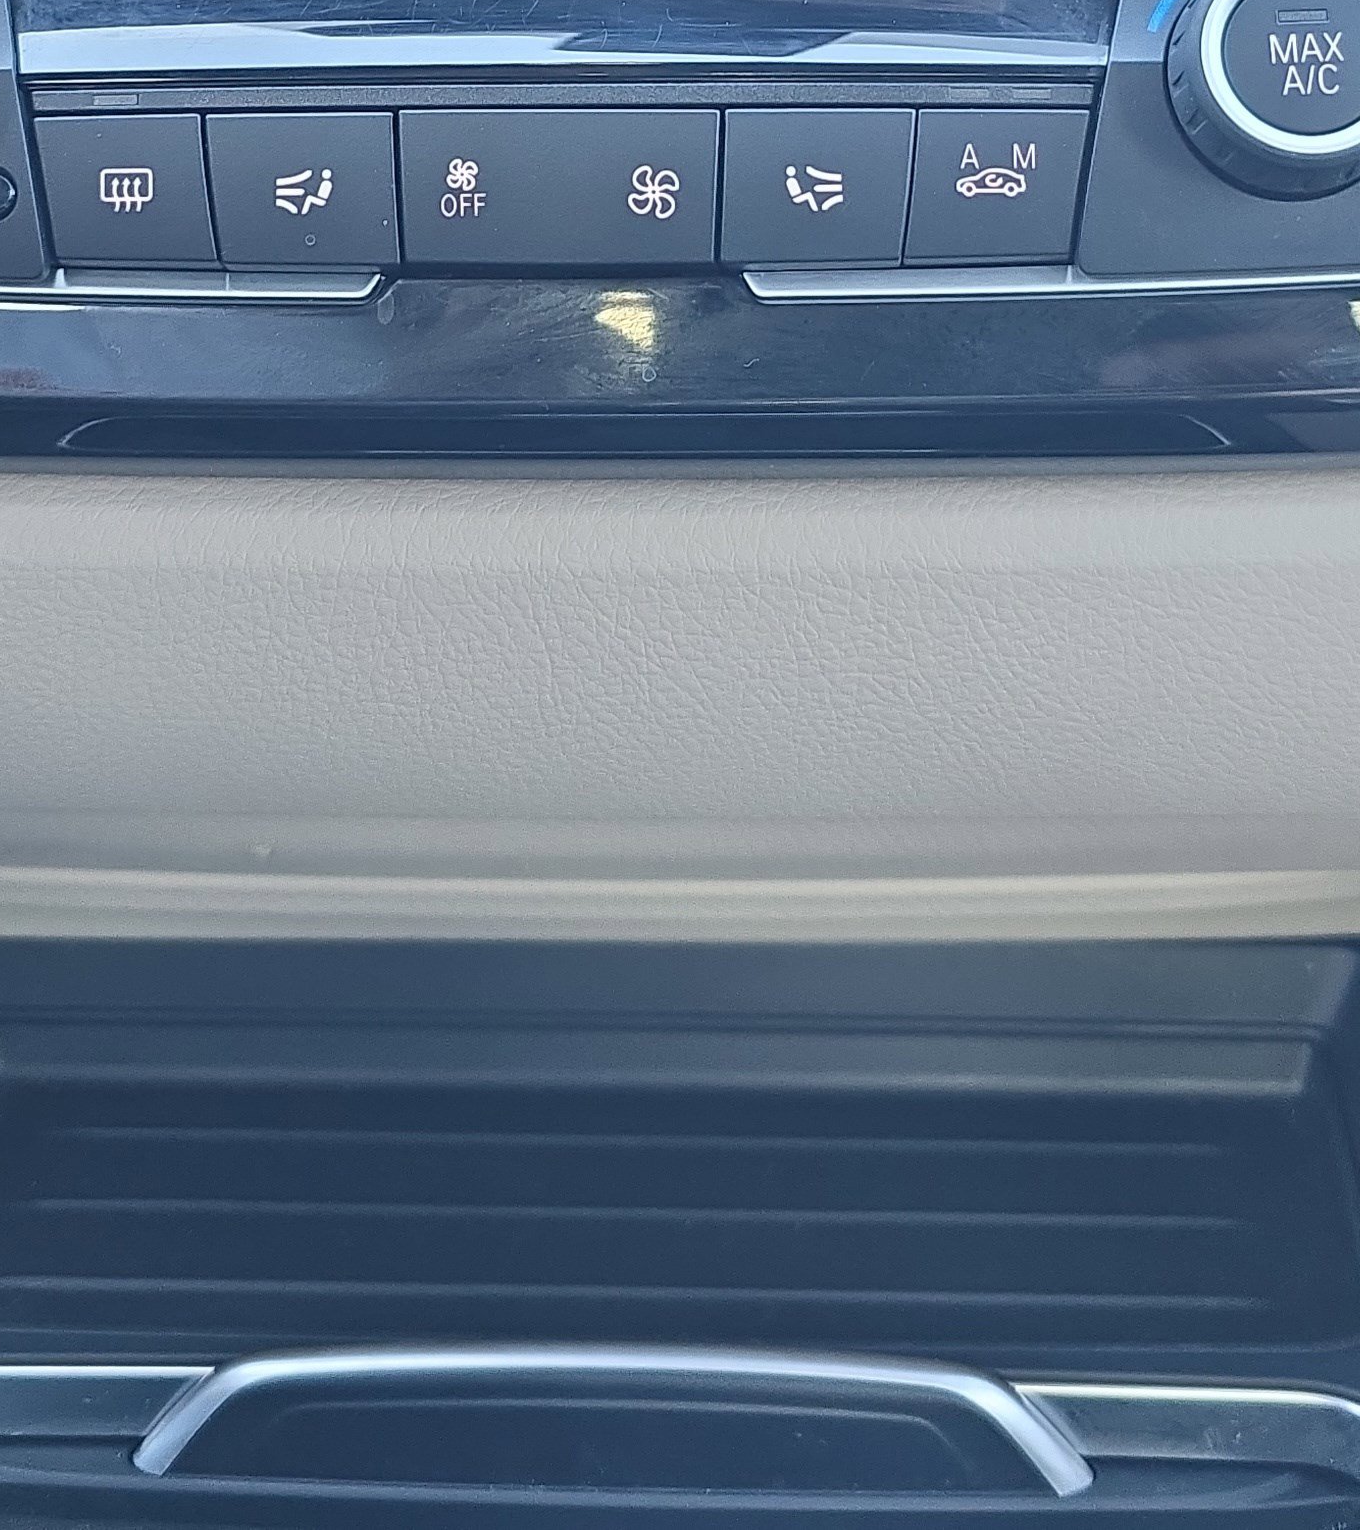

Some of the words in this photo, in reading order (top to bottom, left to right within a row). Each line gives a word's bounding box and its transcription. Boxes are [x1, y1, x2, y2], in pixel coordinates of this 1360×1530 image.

[1269, 32, 1345, 64] MAX
[1282, 64, 1340, 96] A/C
[960, 143, 979, 169] A
[1012, 143, 1037, 169] M
[440, 192, 487, 219] OFF
